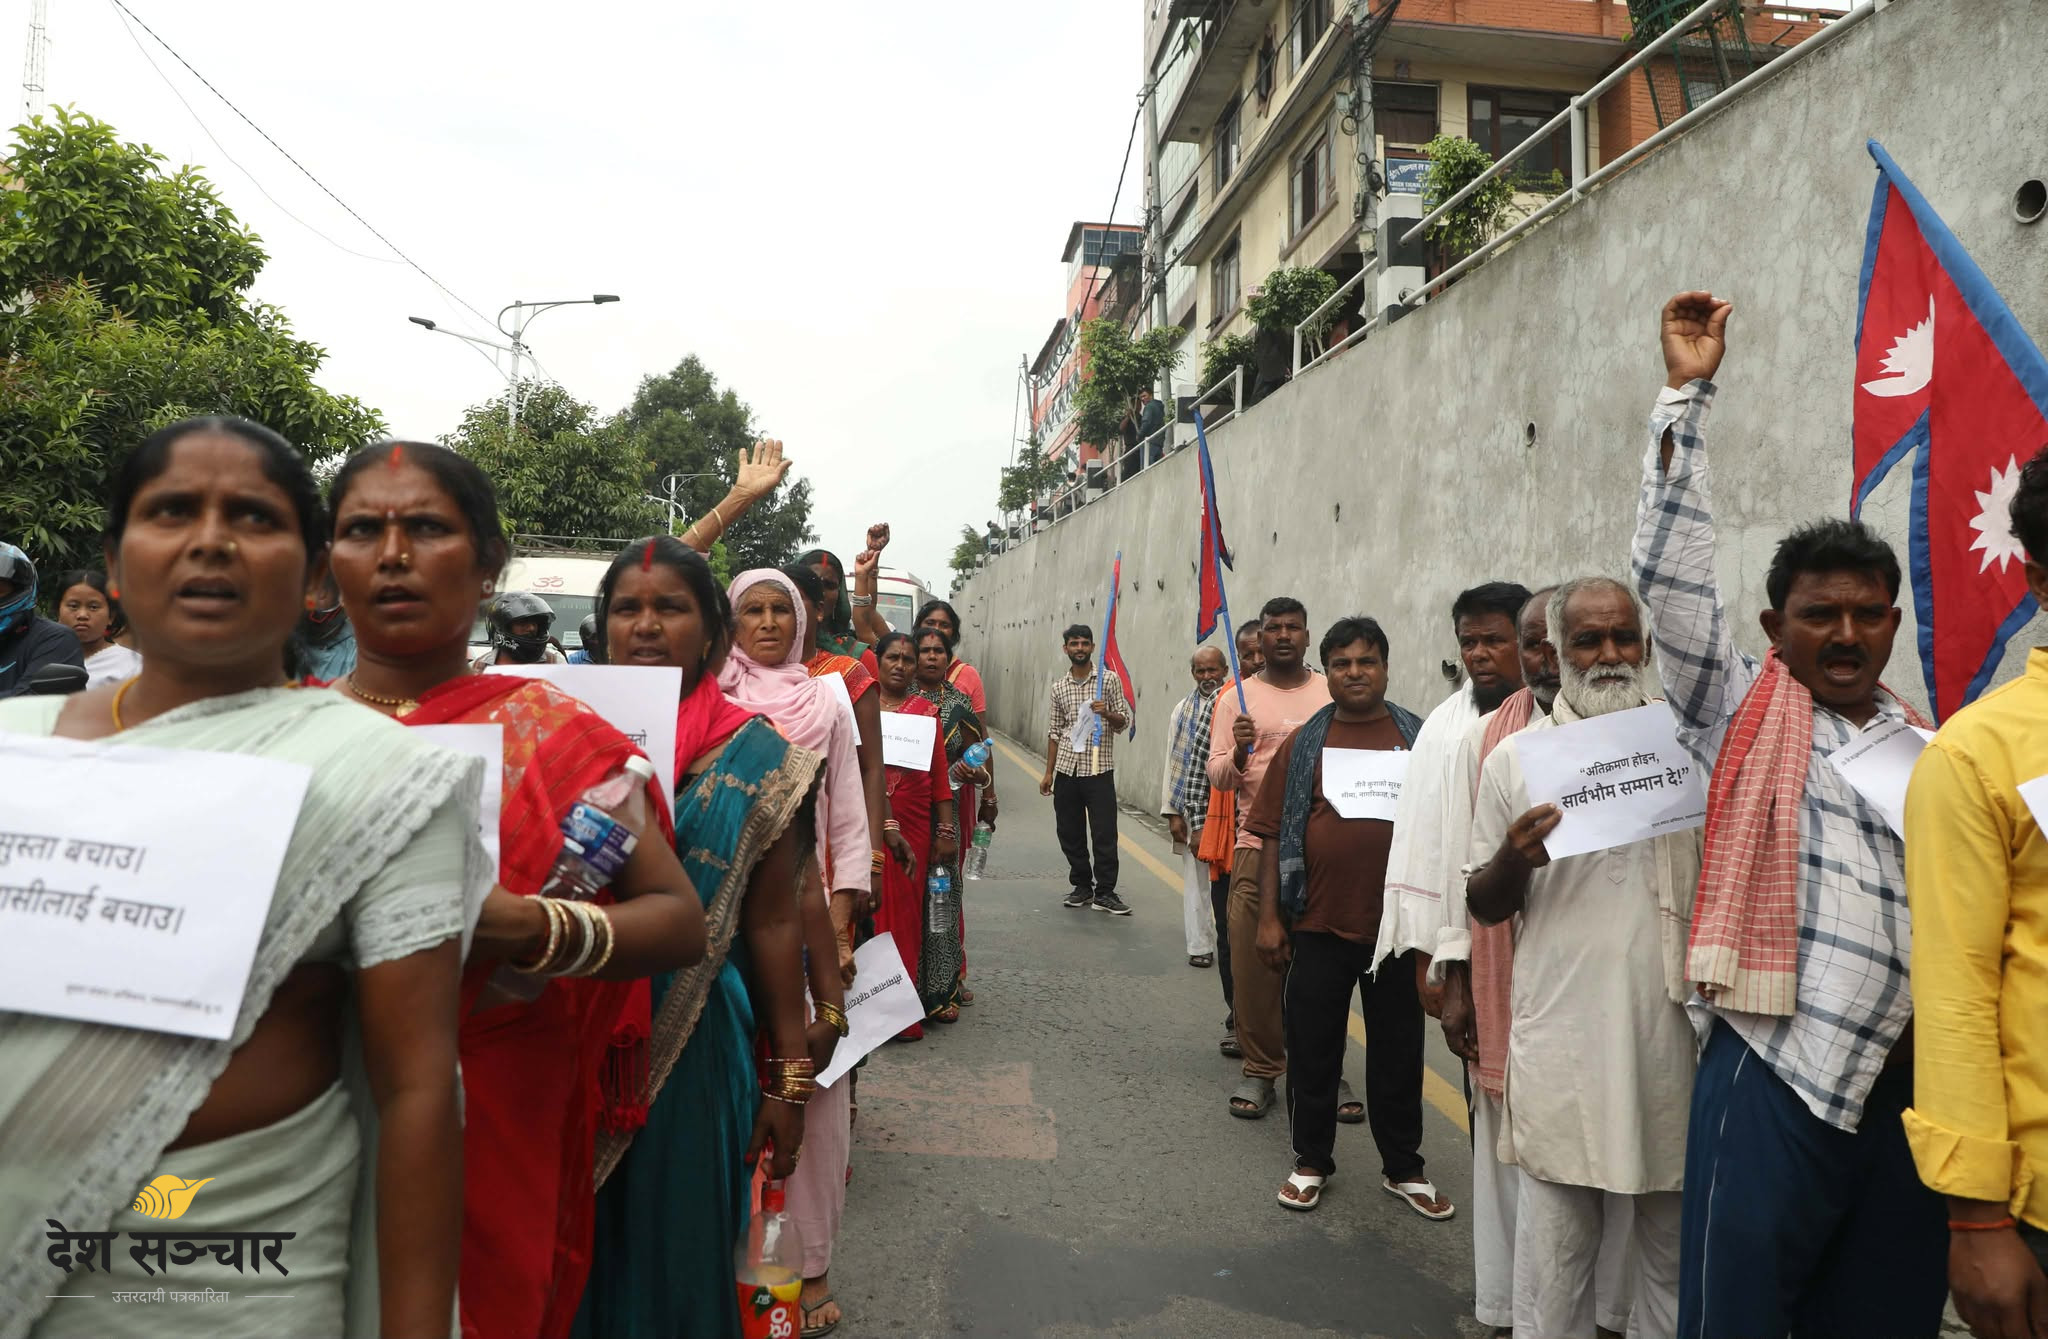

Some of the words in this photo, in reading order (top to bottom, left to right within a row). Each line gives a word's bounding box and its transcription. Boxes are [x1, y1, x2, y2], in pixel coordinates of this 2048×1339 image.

[1580, 758, 1630, 777] “अतिक्रमण
[1632, 752, 1660, 768] होइन,
[1562, 783, 1617, 808] सार्वभौम
[1618, 774, 1664, 796] सम्मान
[1666, 767, 1689, 787] दे!”
[64, 839, 147, 874] बचाउ।
[0, 878, 100, 923] ासीलाई
[100, 897, 185, 935] बचाउ।
[871, 974, 903, 996] सीमानाका
